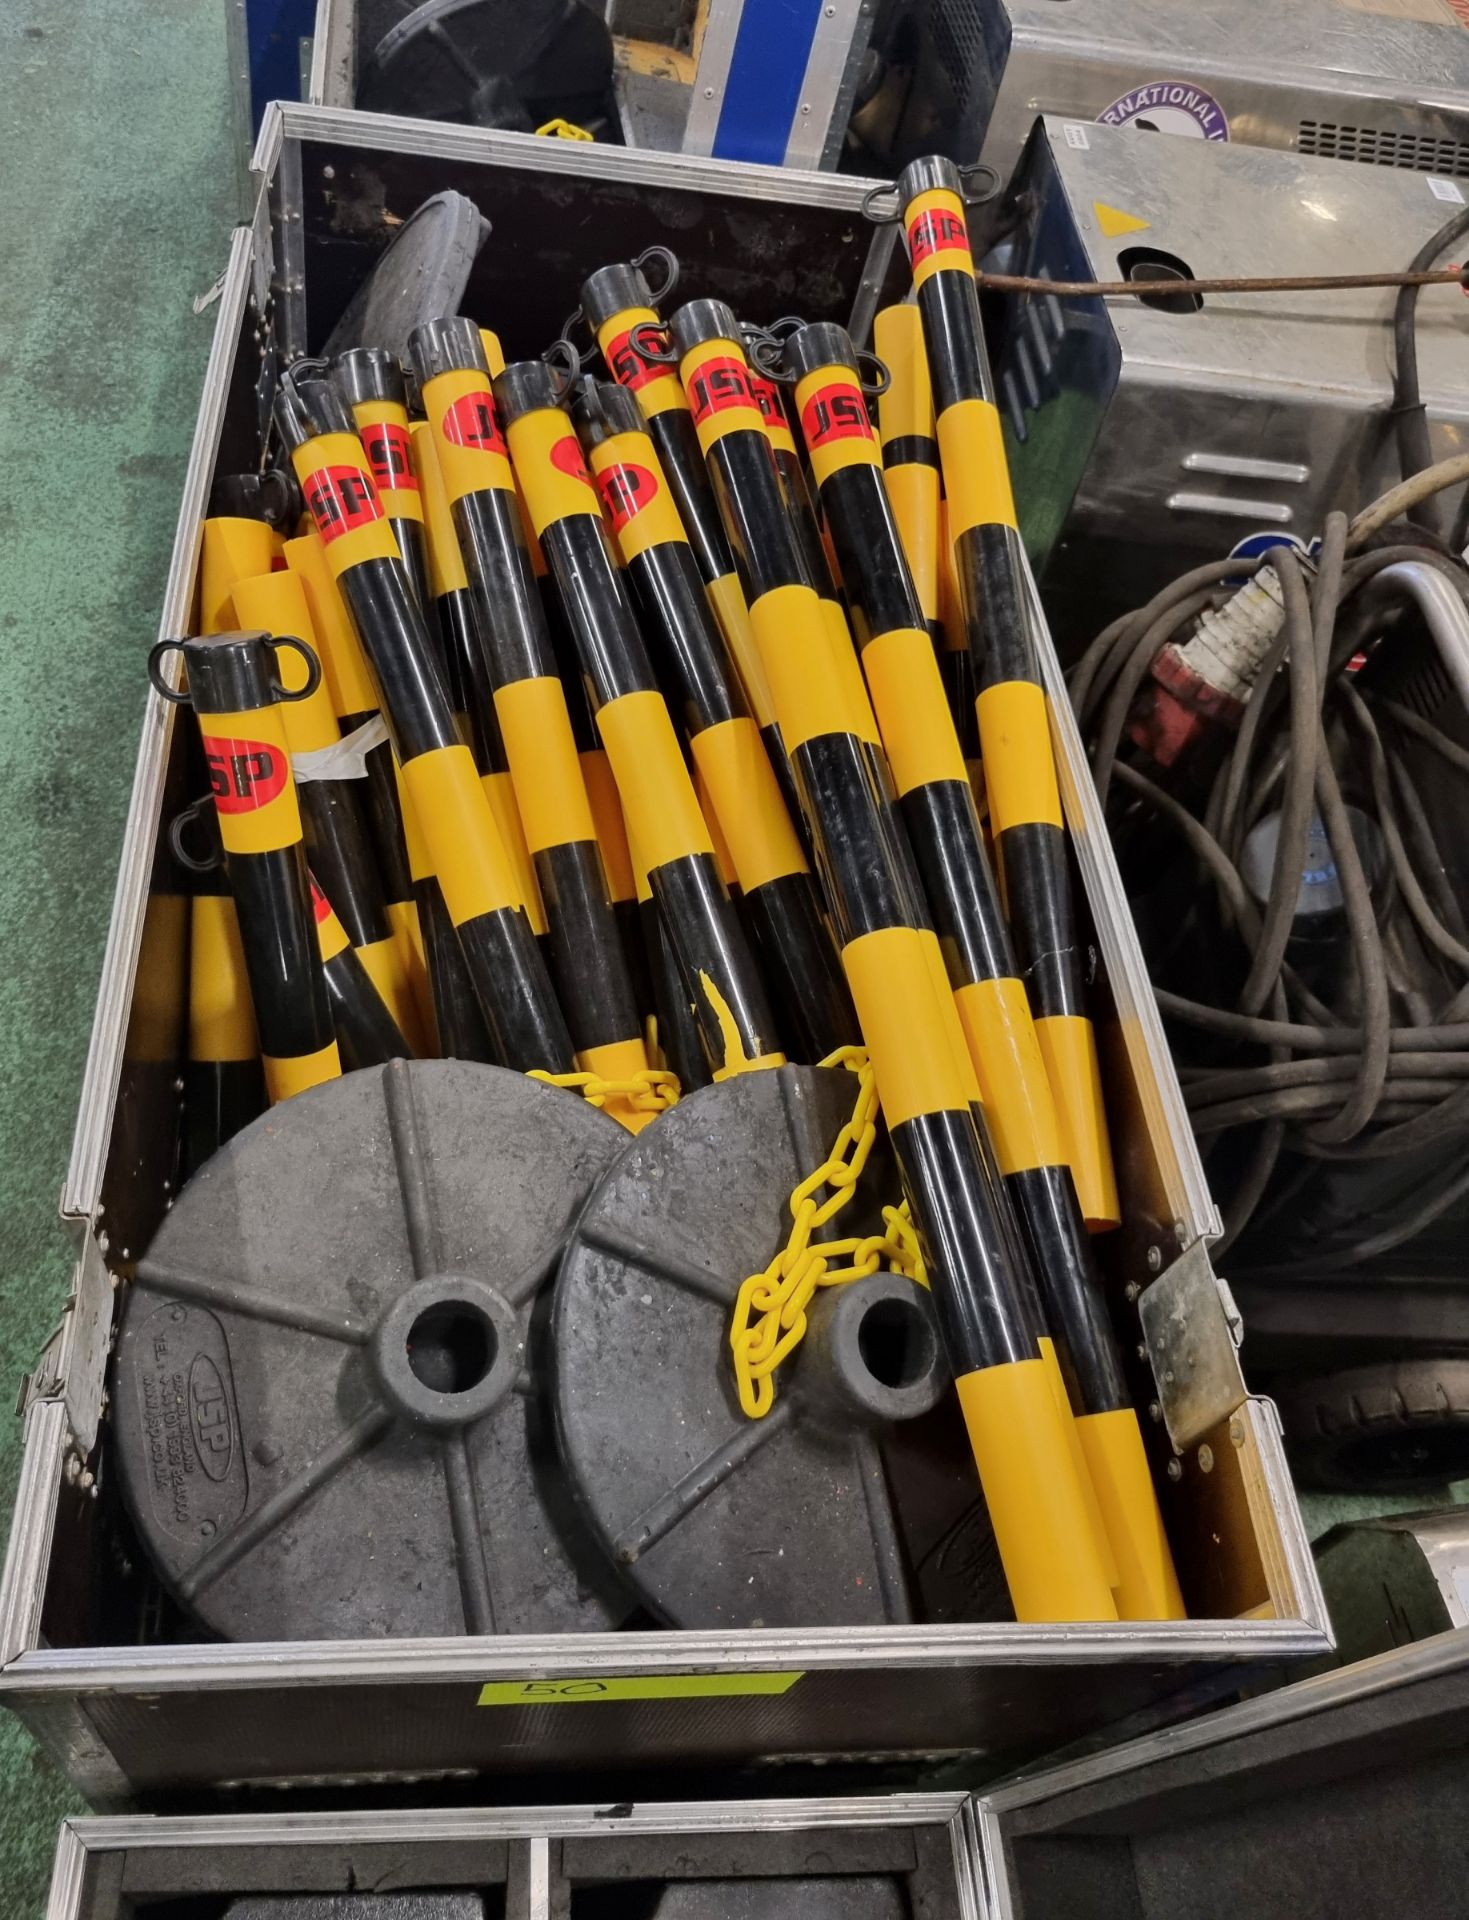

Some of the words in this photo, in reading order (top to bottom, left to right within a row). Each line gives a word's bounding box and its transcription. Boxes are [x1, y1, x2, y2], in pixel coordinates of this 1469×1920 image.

[910, 217, 966, 254] SP
[694, 368, 757, 420] JS
[812, 396, 872, 443] JS
[192, 1380, 231, 1454] JSP
[520, 1681, 608, 1697] 50
